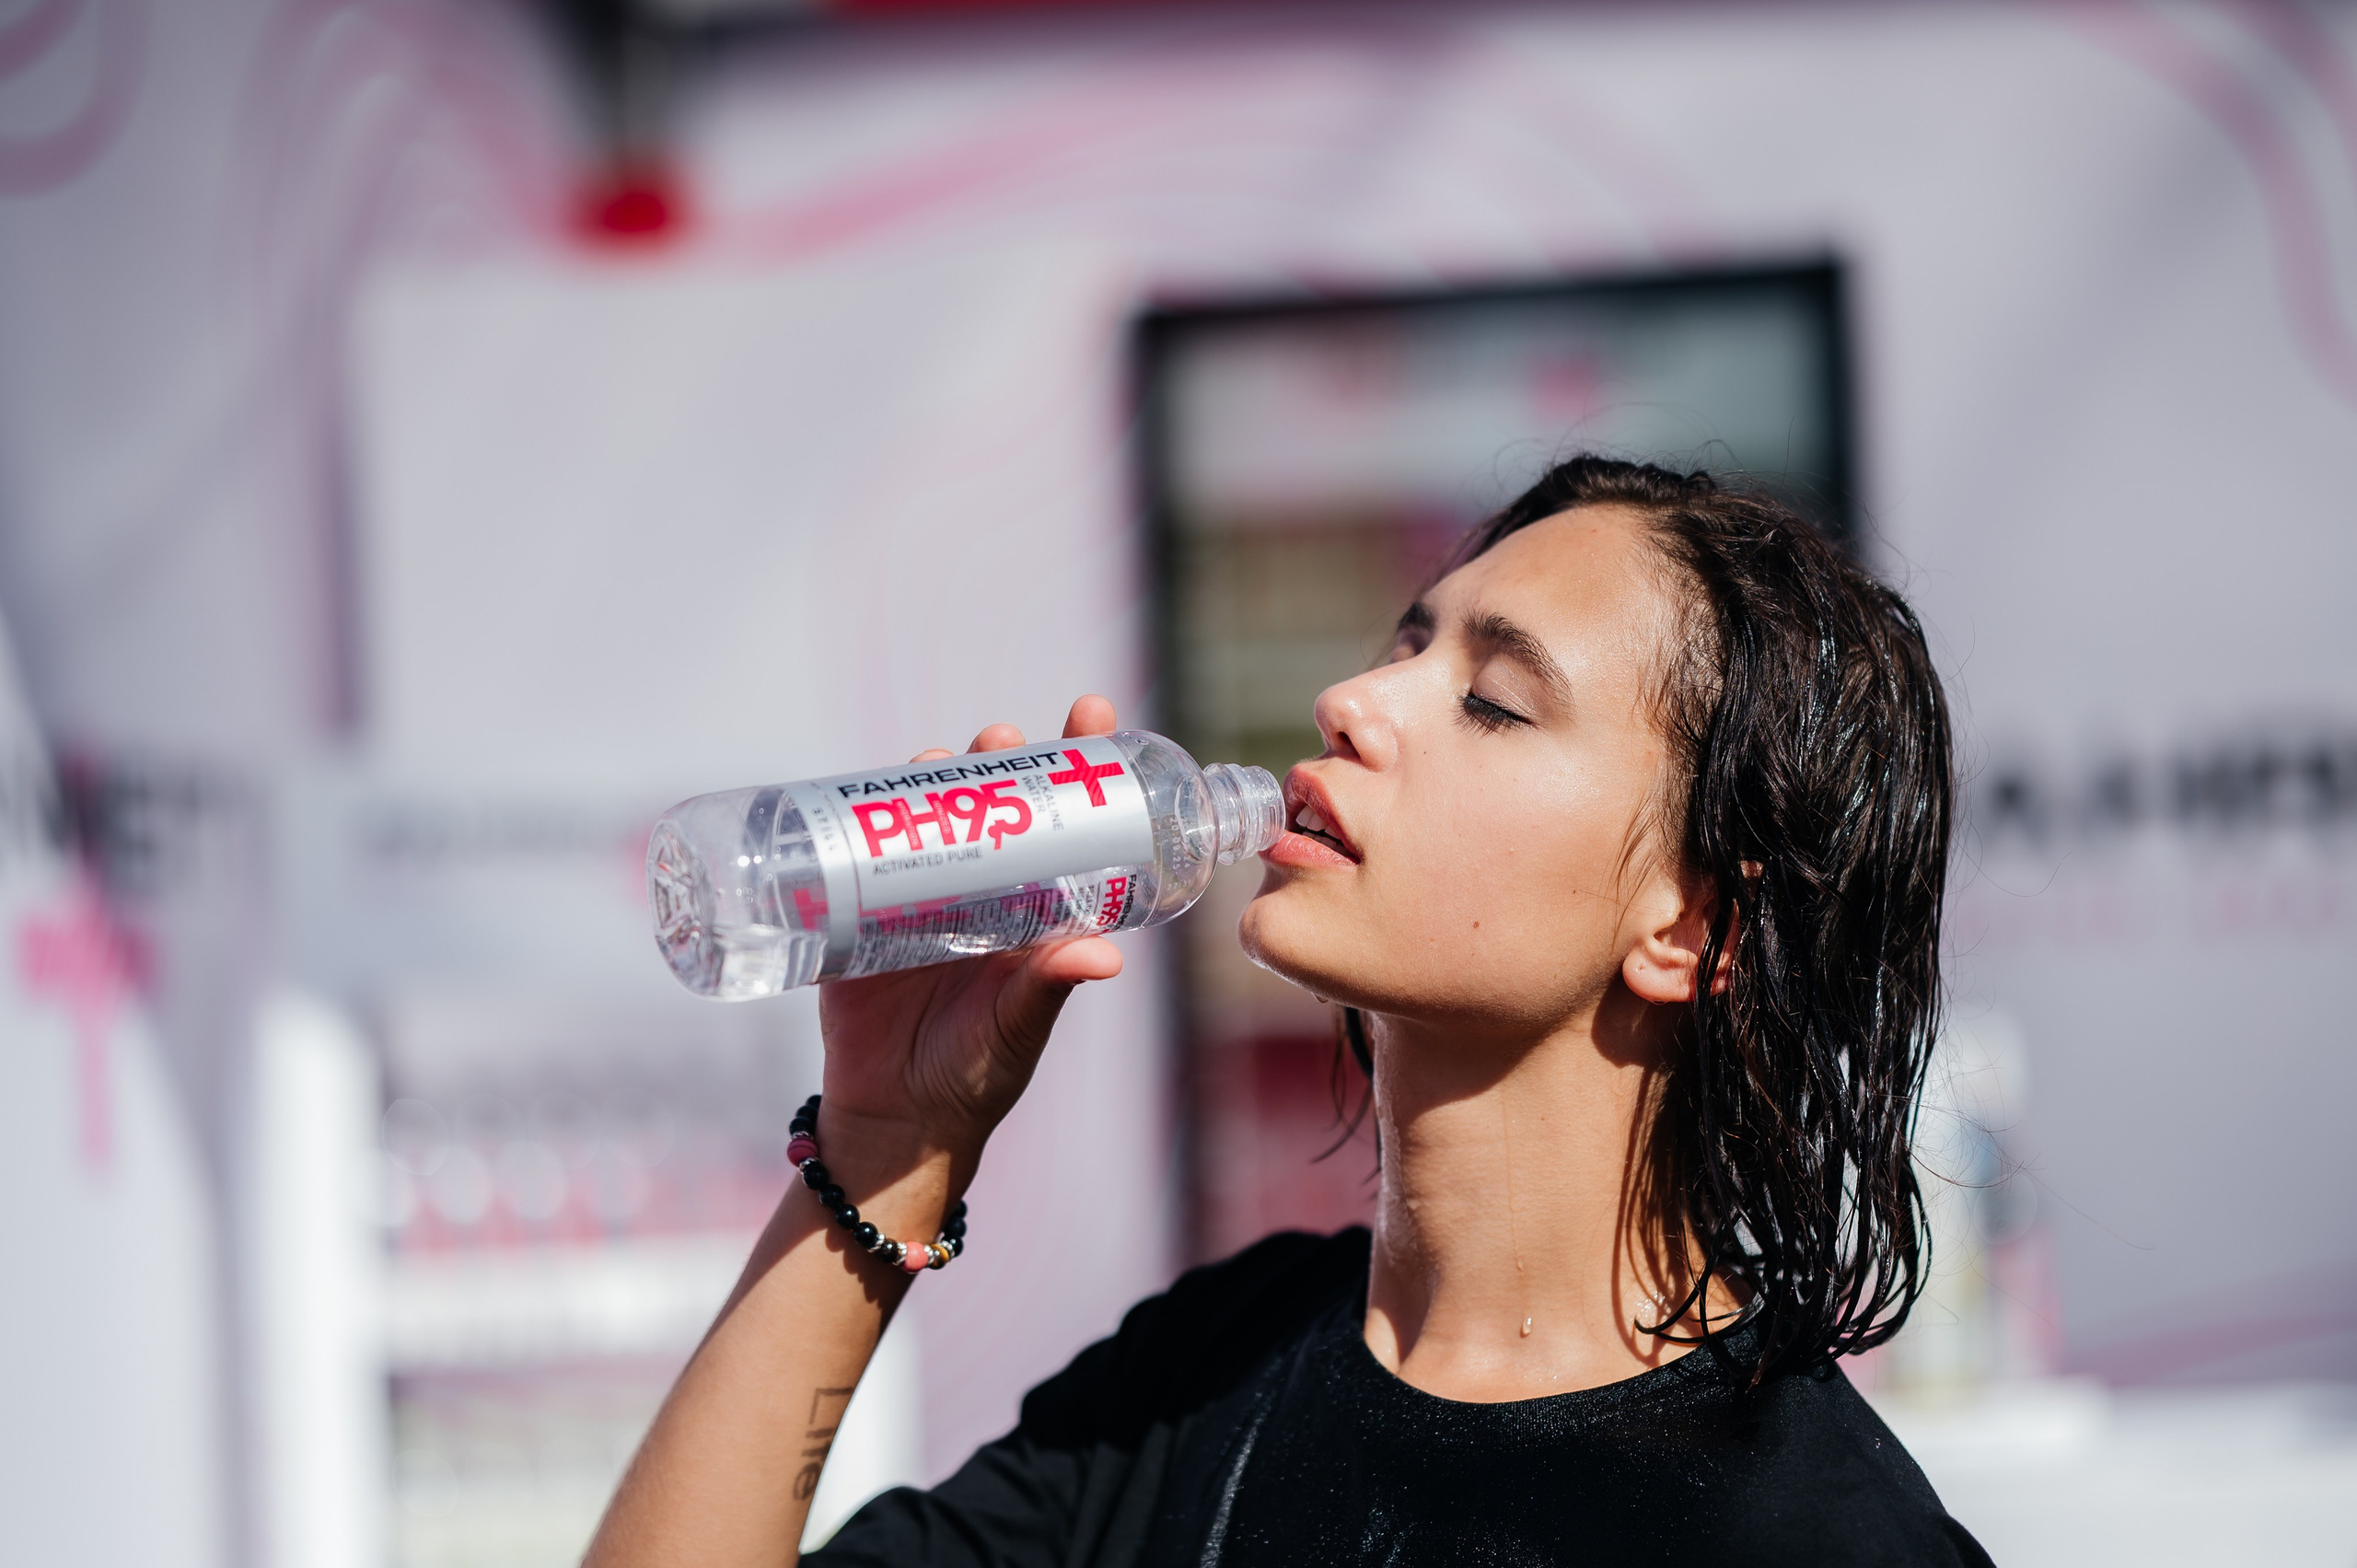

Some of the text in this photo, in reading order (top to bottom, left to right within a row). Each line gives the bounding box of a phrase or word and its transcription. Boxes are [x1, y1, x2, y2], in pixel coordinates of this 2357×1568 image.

[838, 751, 1059, 798] FAHRENHEIT
[1021, 775, 1046, 814] WATER
[1031, 773, 1064, 831] ALKALINE
[873, 846, 983, 875] ACTIVATED PURE
